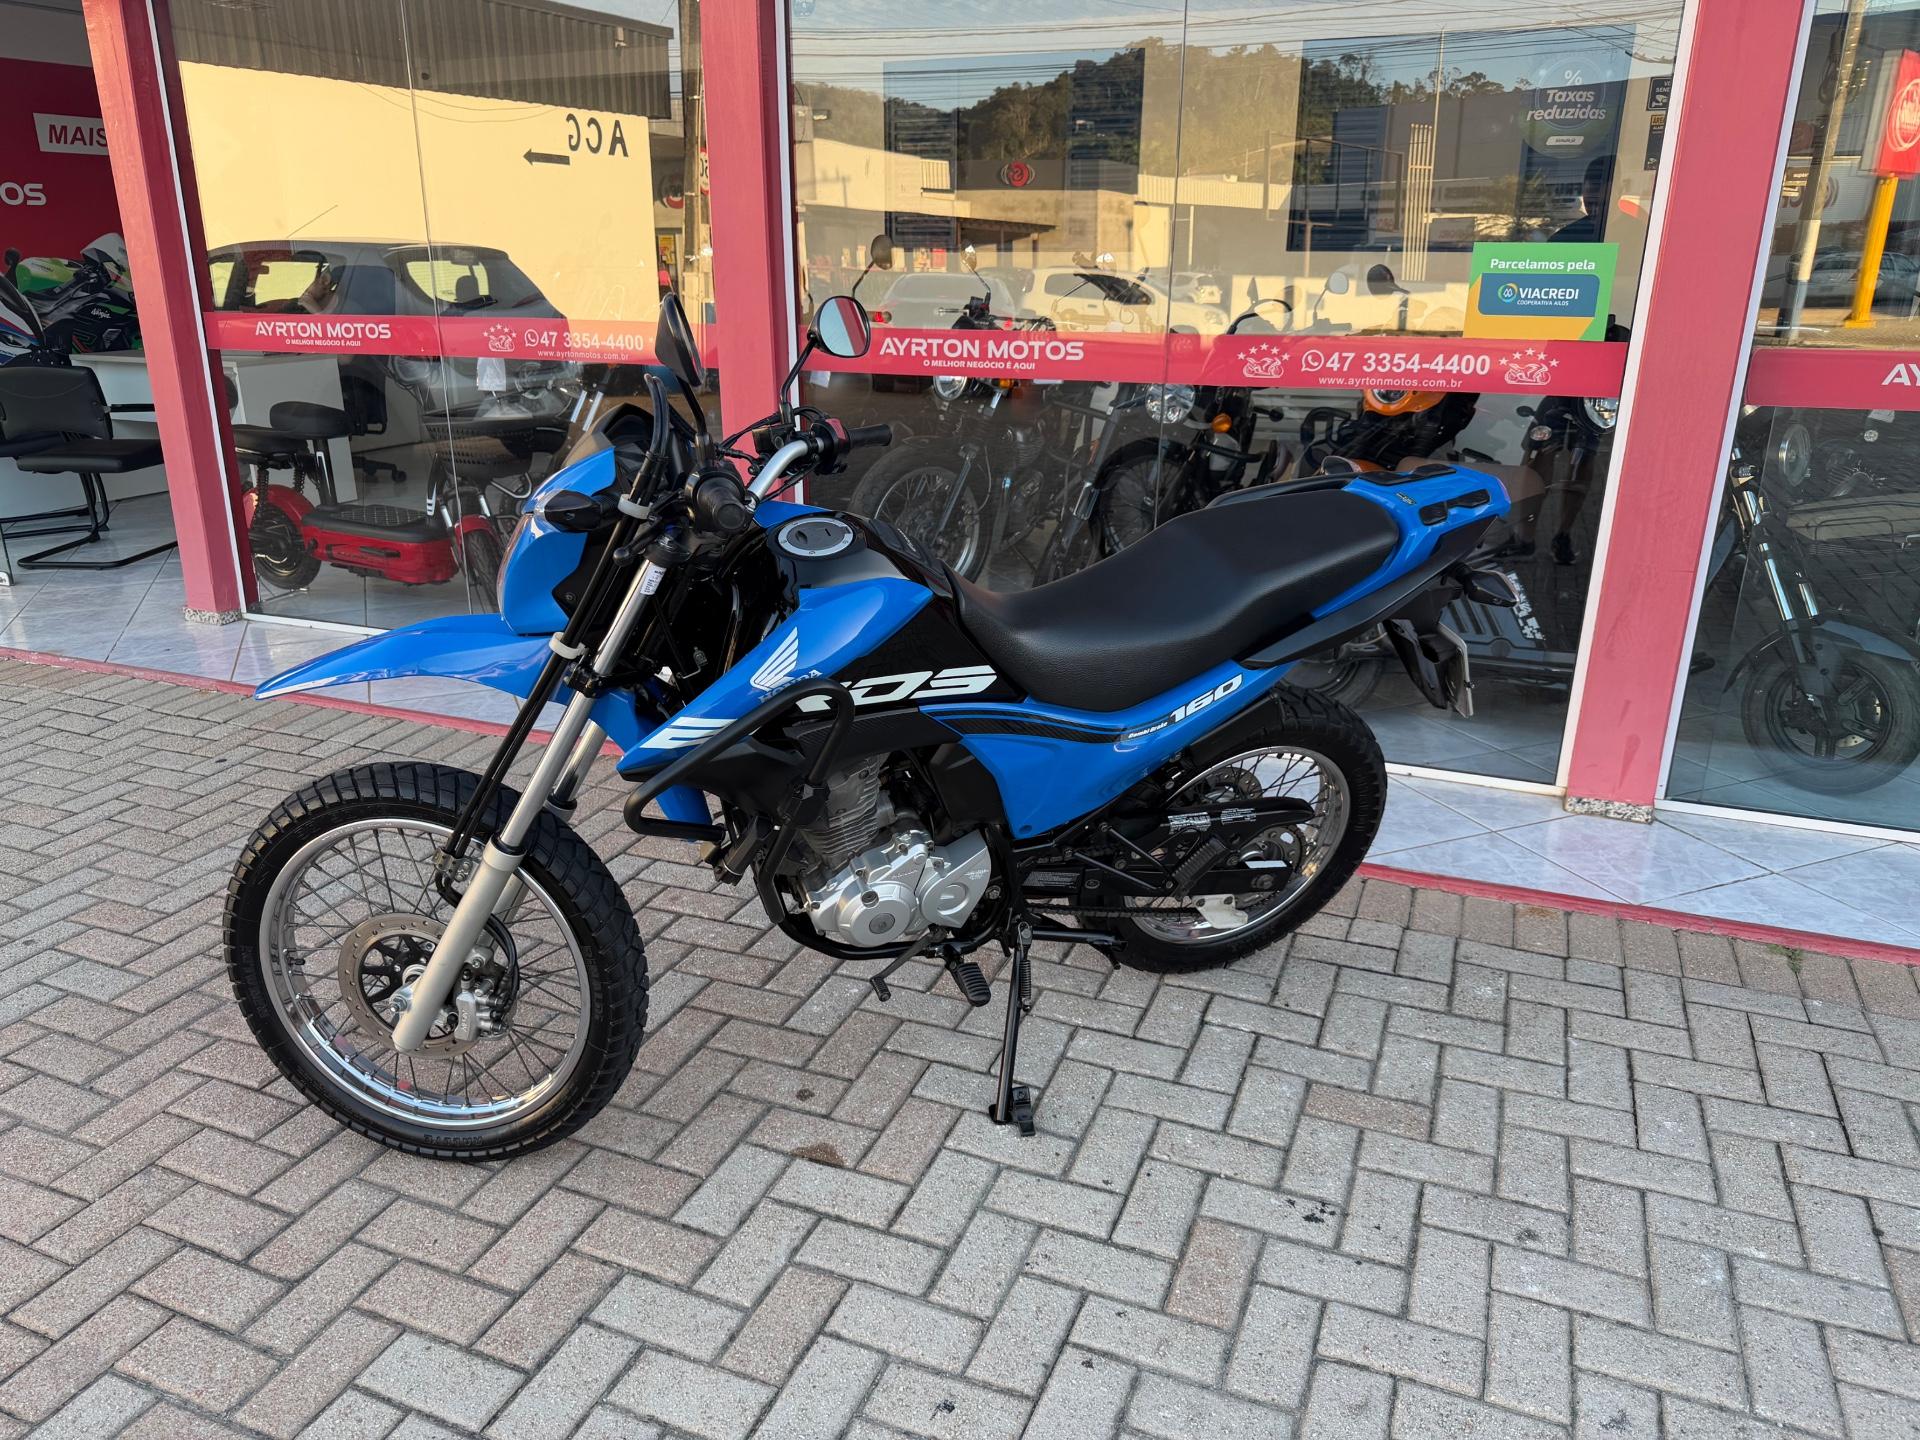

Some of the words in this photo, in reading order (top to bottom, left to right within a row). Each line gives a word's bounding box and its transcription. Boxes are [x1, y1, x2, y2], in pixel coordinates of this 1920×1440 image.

[1546, 89, 1596, 103] Taxas
[1526, 104, 1607, 121] reduzidas
[48, 124, 108, 147] MAIS
[0, 181, 47, 206] OS
[1490, 258, 1565, 270] Parcelamos
[1567, 259, 1596, 272] pela
[1519, 287, 1579, 300] VIACREDI
[255, 321, 322, 338] AYRTON
[326, 323, 392, 339] MOTOS
[315, 338, 341, 347] NEGÓCIO
[540, 331, 558, 347] 47
[563, 332, 644, 350] 3354-4400
[879, 337, 979, 358] AYRTON
[987, 339, 1085, 361] MOTOS
[537, 350, 629, 361] www.ayrtonmotos.com.br
[931, 360, 966, 368] MELHOR
[966, 358, 1005, 369] NEGÓCIO
[1006, 360, 1011, 369] É
[1013, 361, 1035, 370] AQUI
[1325, 351, 1355, 372] 47
[1362, 352, 1491, 376] 3354-4400
[1318, 376, 1463, 389] www.ayrtonmotos.com.br
[1170, 673, 1243, 722] 160
